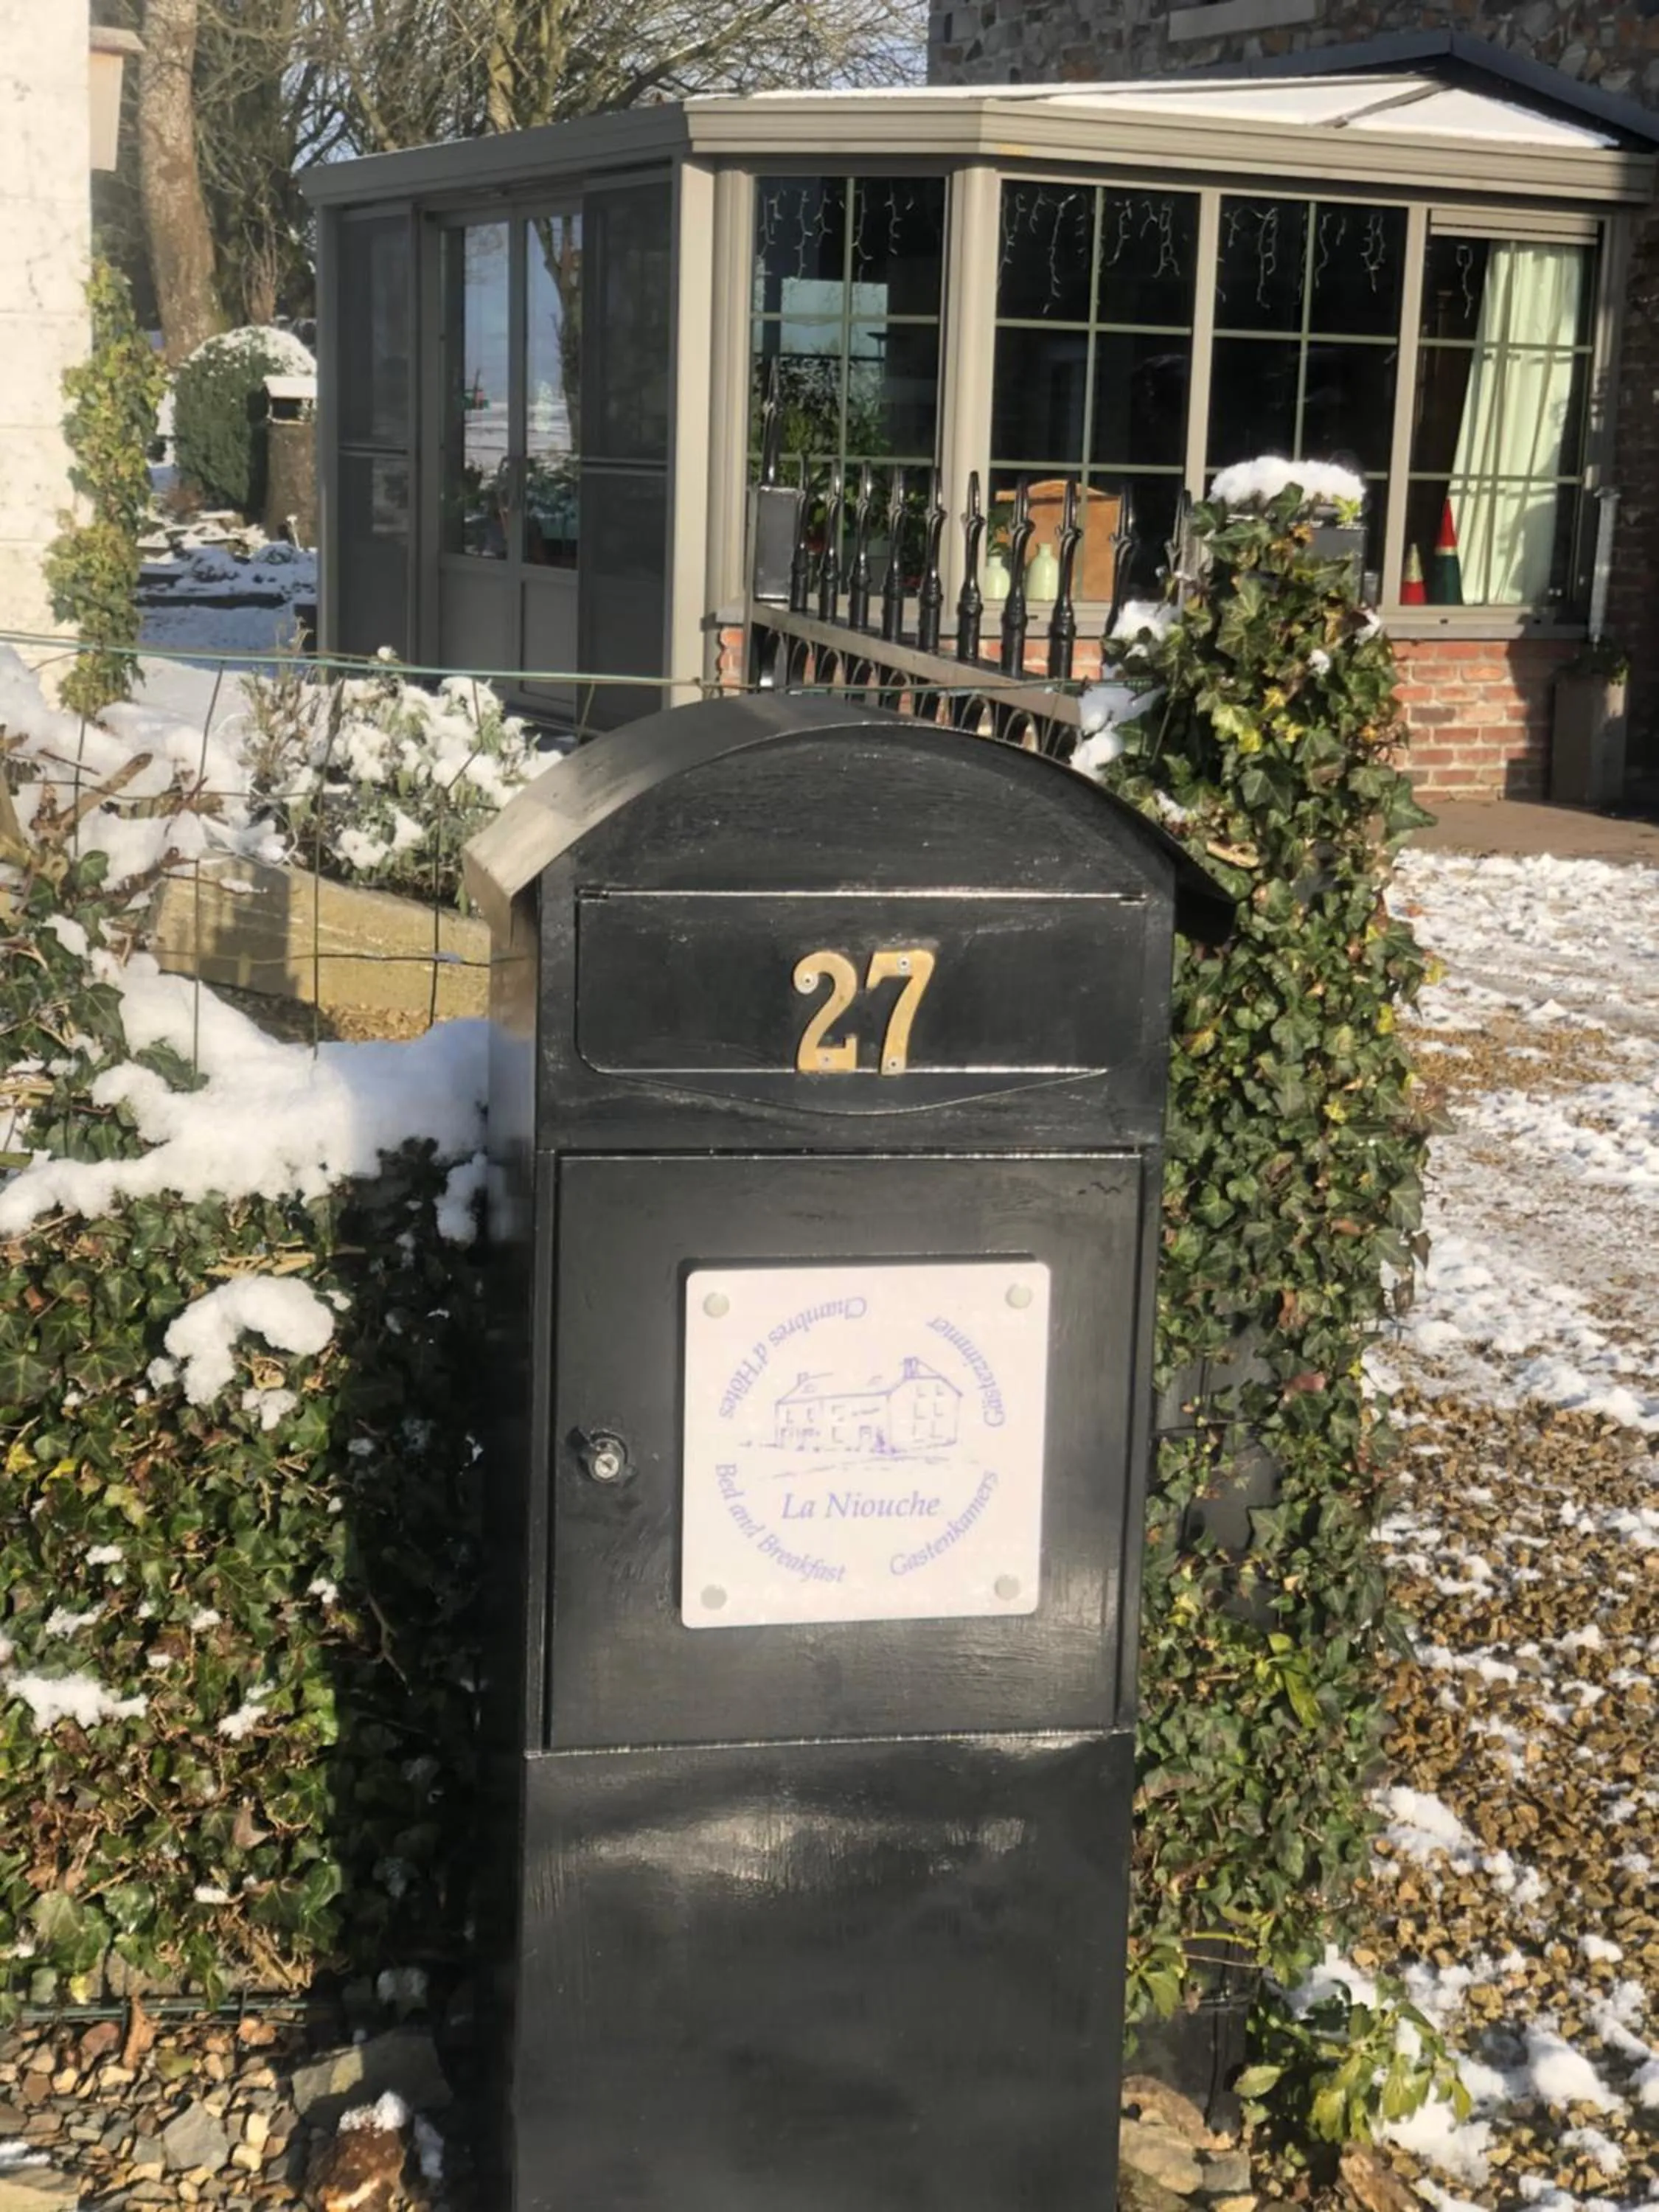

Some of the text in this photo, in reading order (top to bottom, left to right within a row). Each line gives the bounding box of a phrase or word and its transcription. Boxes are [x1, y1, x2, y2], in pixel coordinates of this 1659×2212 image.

[793, 950, 935, 1076] 27
[768, 1296, 867, 1346] Chambres
[715, 1463, 846, 1583] Bed and Breakfast
[782, 1490, 941, 1520] La Niouche
[889, 1470, 998, 1576] Gastenkamers
